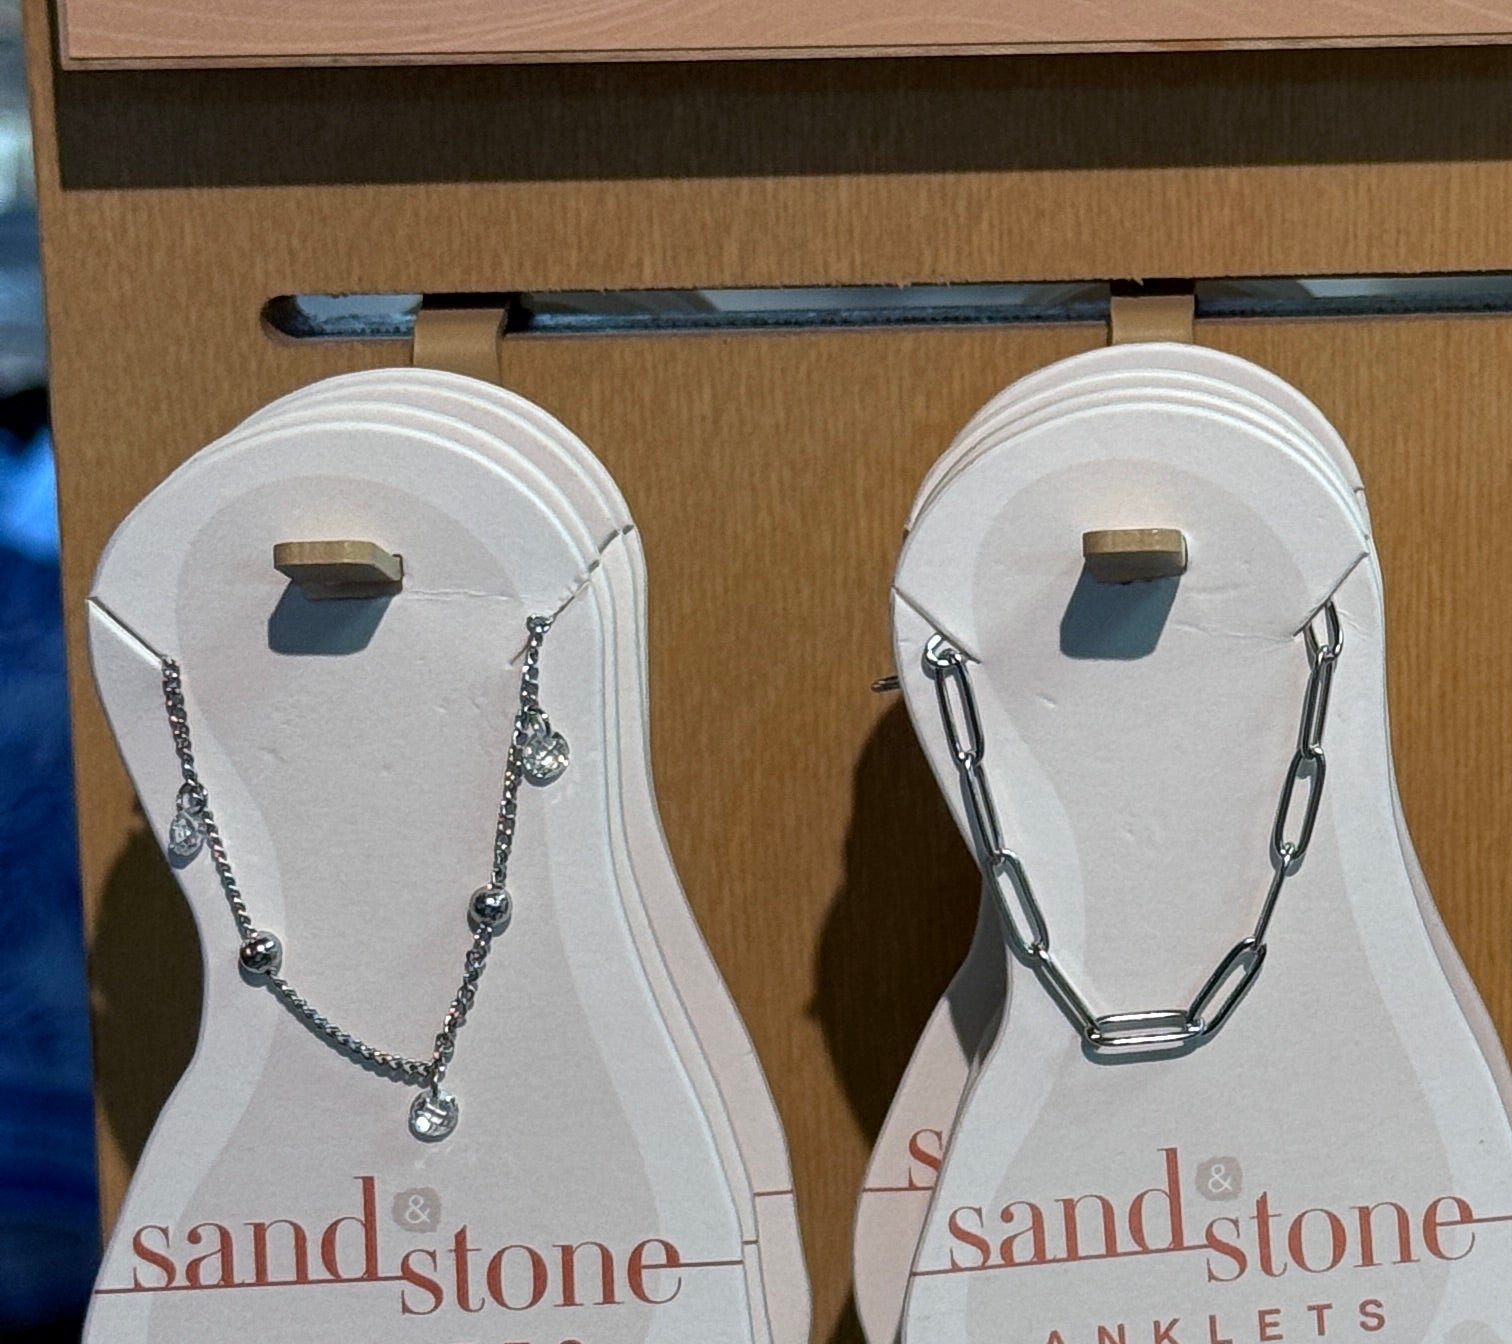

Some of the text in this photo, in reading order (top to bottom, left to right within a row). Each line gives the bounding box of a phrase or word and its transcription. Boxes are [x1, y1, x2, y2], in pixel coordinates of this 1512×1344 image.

[947, 1147, 1182, 1273] sand
[1206, 1162, 1234, 1195] &
[132, 1175, 683, 1316] sand & stone
[1204, 1190, 1477, 1285] stone
